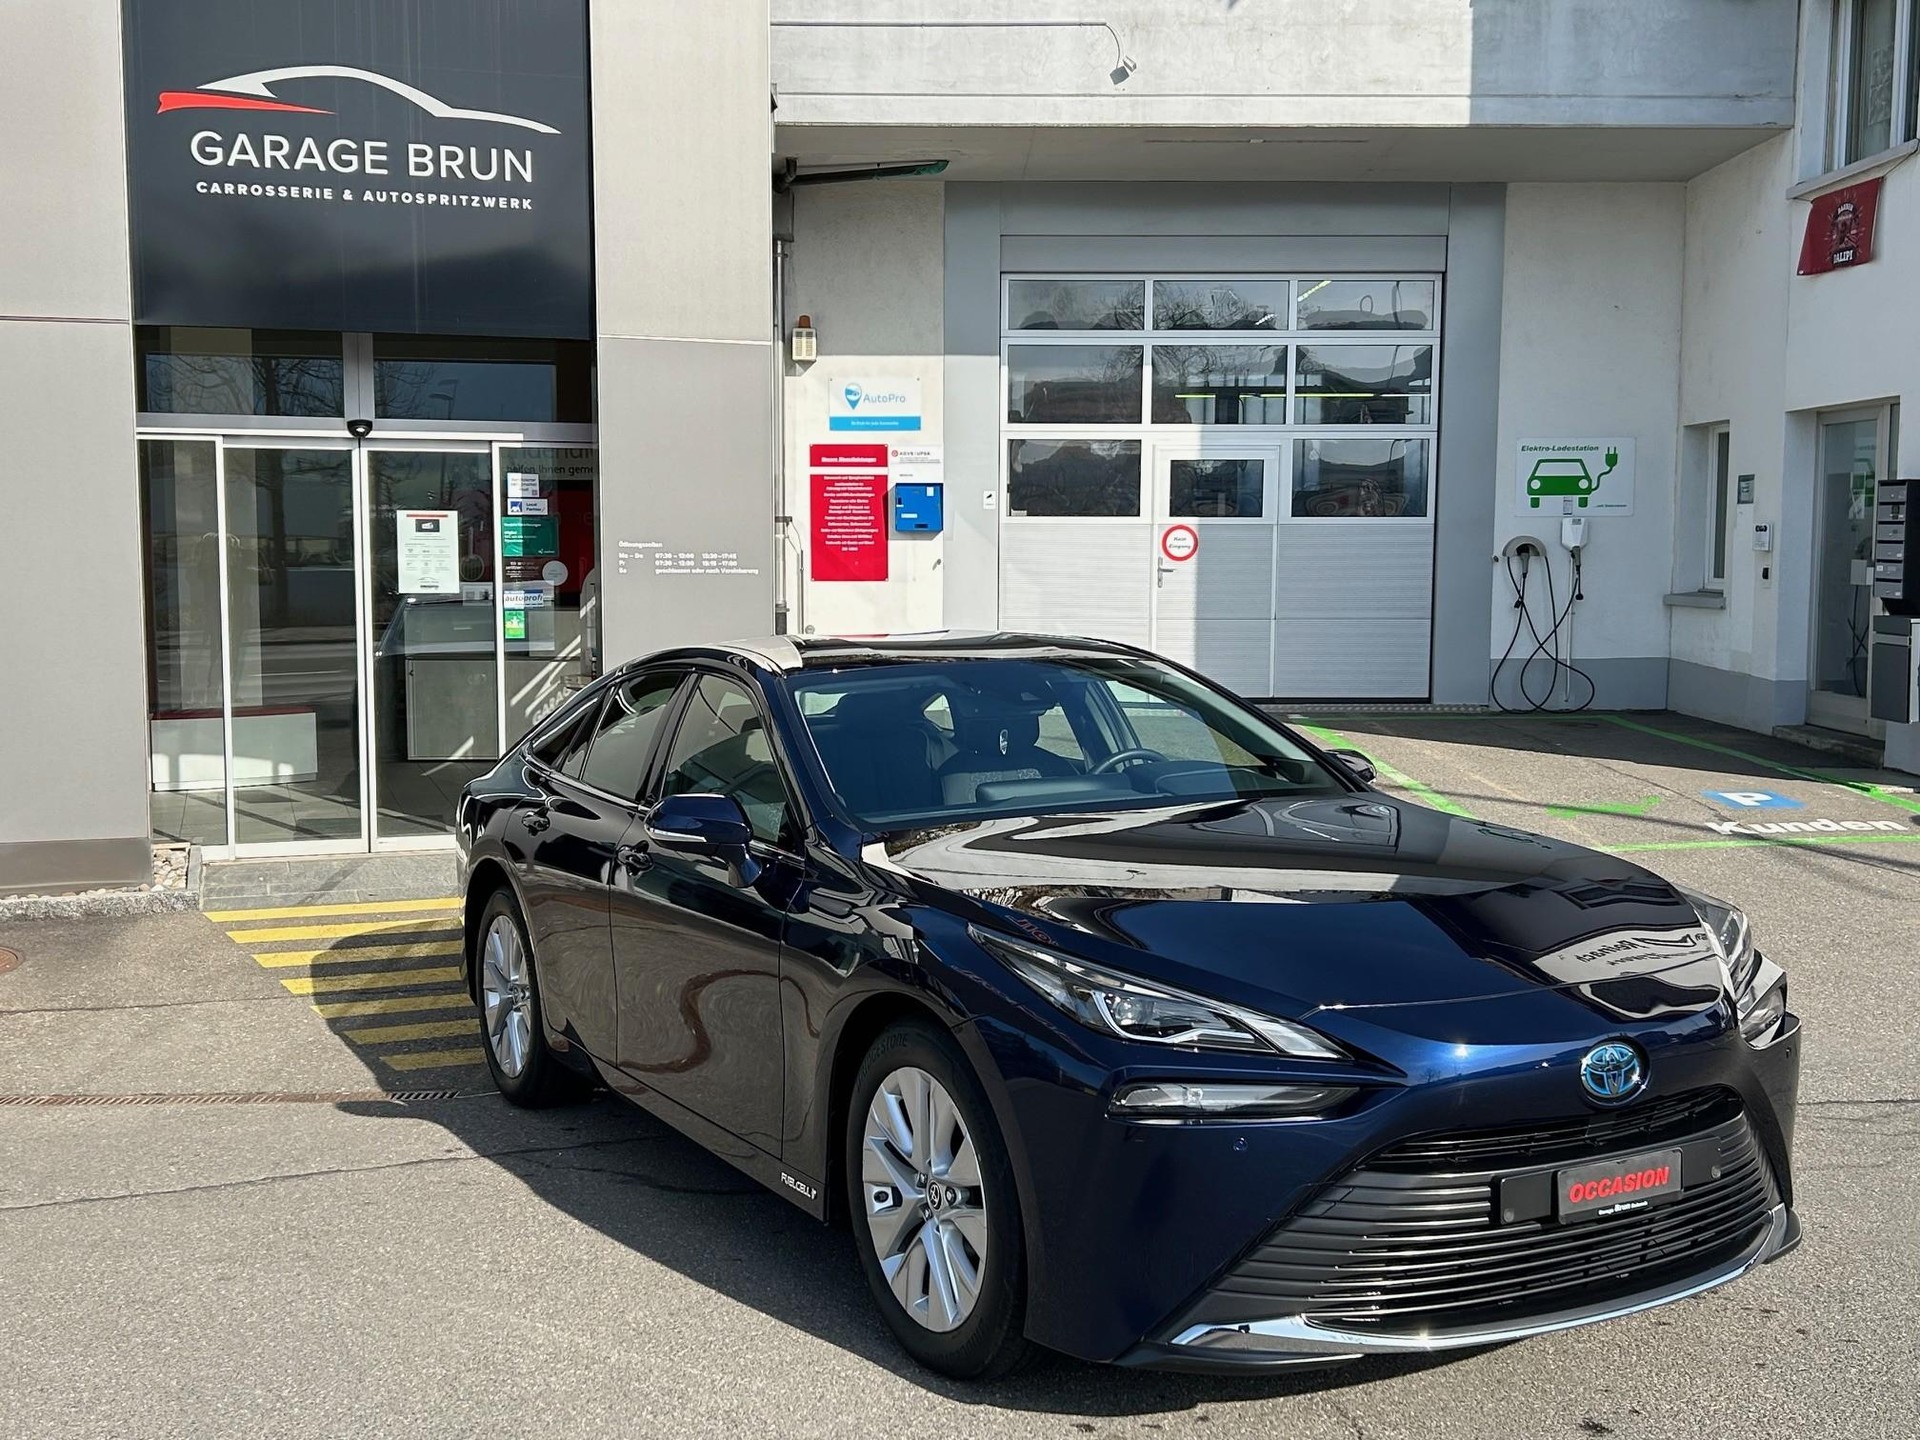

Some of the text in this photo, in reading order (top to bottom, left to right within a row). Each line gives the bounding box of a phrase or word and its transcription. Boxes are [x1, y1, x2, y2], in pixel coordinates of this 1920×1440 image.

[190, 130, 533, 183] GARAGE BRUN
[195, 181, 533, 210] CARROSSERIE & AUTOSPRITZWERK
[863, 393, 906, 404] AutoPro
[1520, 444, 1600, 452] Elektro-Ladestation
[1705, 818, 1910, 835] Kunden
[1568, 1166, 1670, 1204] OCCASION
